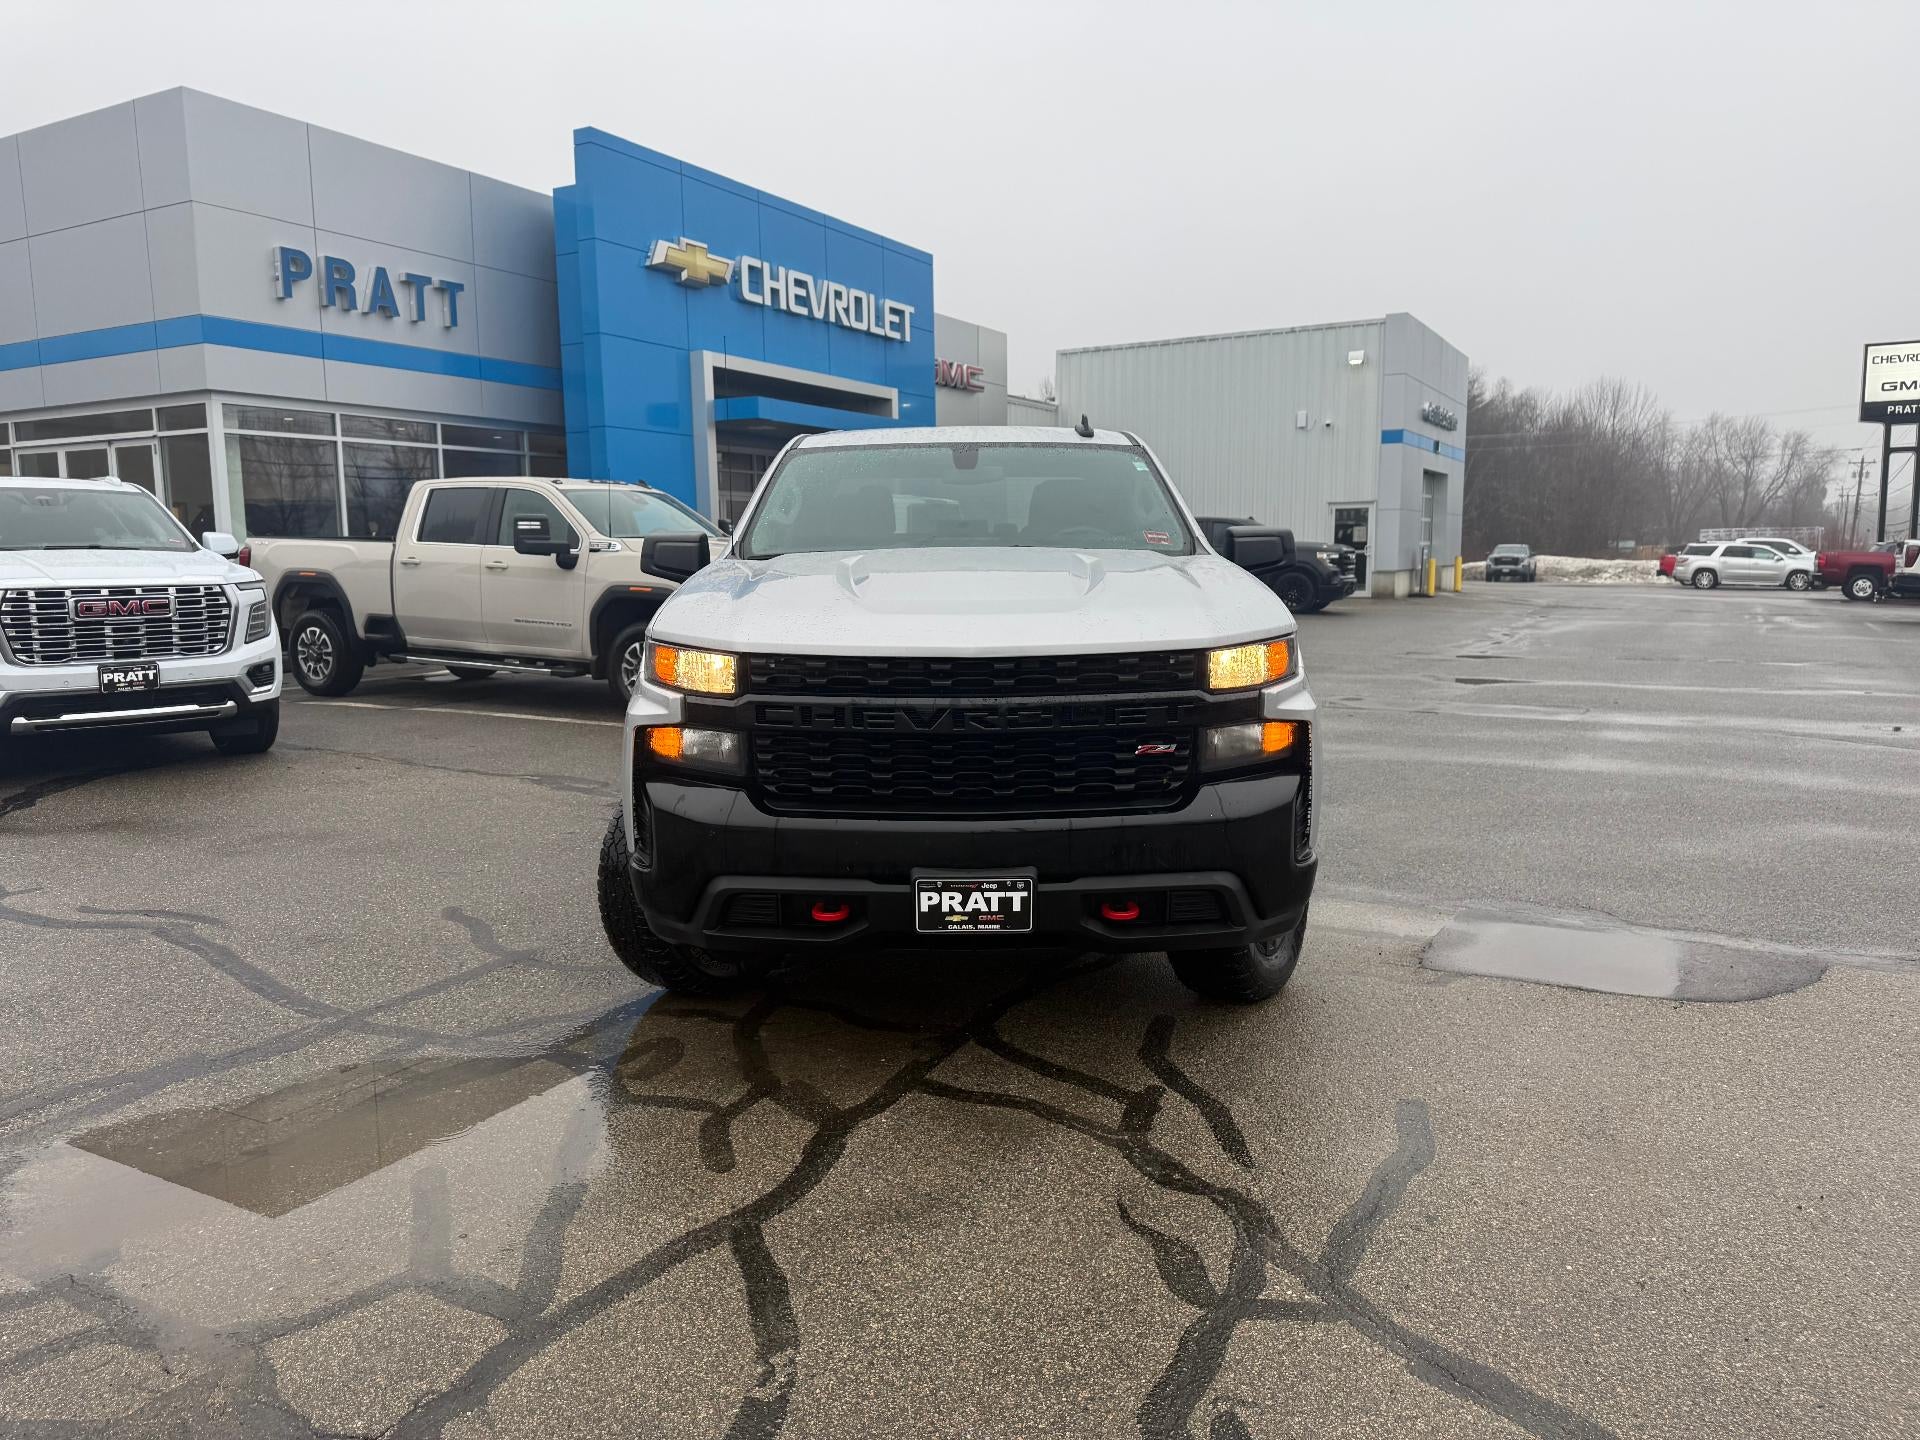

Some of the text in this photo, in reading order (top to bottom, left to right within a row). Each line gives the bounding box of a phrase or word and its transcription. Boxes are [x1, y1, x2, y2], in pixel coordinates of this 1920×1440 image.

[274, 246, 465, 327] PRATT
[738, 255, 915, 342] CHEVROLET
[935, 358, 984, 392] MC
[1881, 380, 1920, 391] GM
[1887, 404, 1920, 414] PRAT
[78, 600, 169, 616] GMC
[103, 670, 156, 683] PRATT
[754, 703, 1194, 730] CHEVROLET
[981, 882, 998, 890] Jeep
[920, 891, 1028, 912] PRATT
